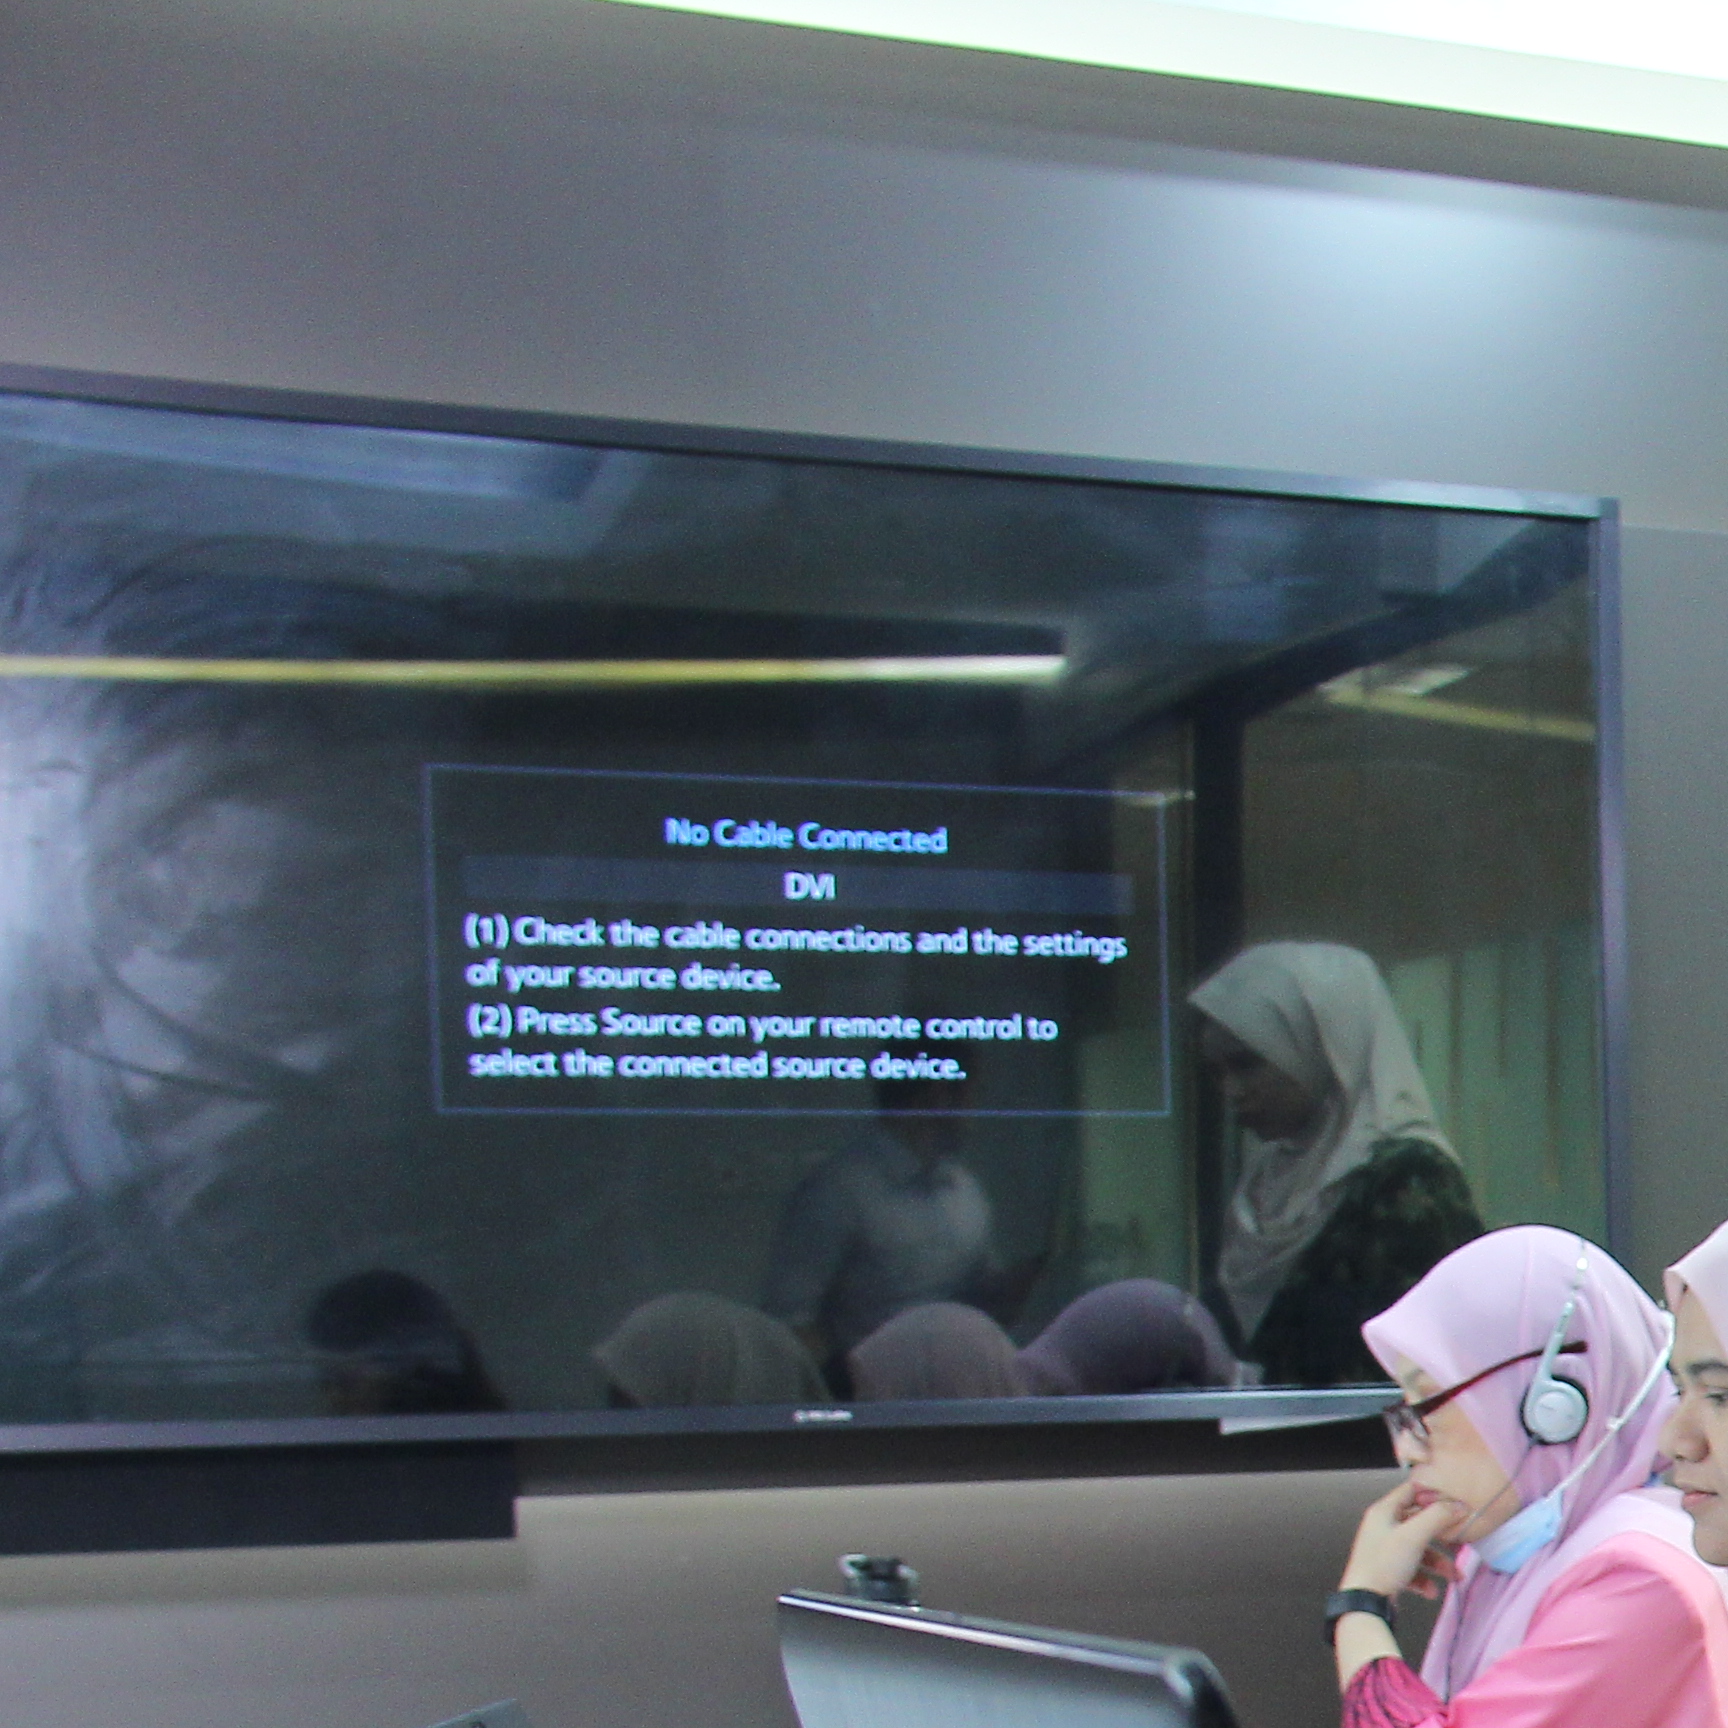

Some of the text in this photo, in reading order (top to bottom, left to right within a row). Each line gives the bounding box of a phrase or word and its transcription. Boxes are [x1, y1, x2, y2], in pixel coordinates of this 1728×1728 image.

[665, 818, 949, 854] No Cable Connected
[784, 871, 837, 901] DVI
[464, 912, 1128, 965] (1) Check the cable connections and the settings
[465, 957, 782, 994] of your source device.
[466, 1001, 1059, 1044] (2) Press Source on your remote control to
[467, 1047, 967, 1083] select the connected source device.
